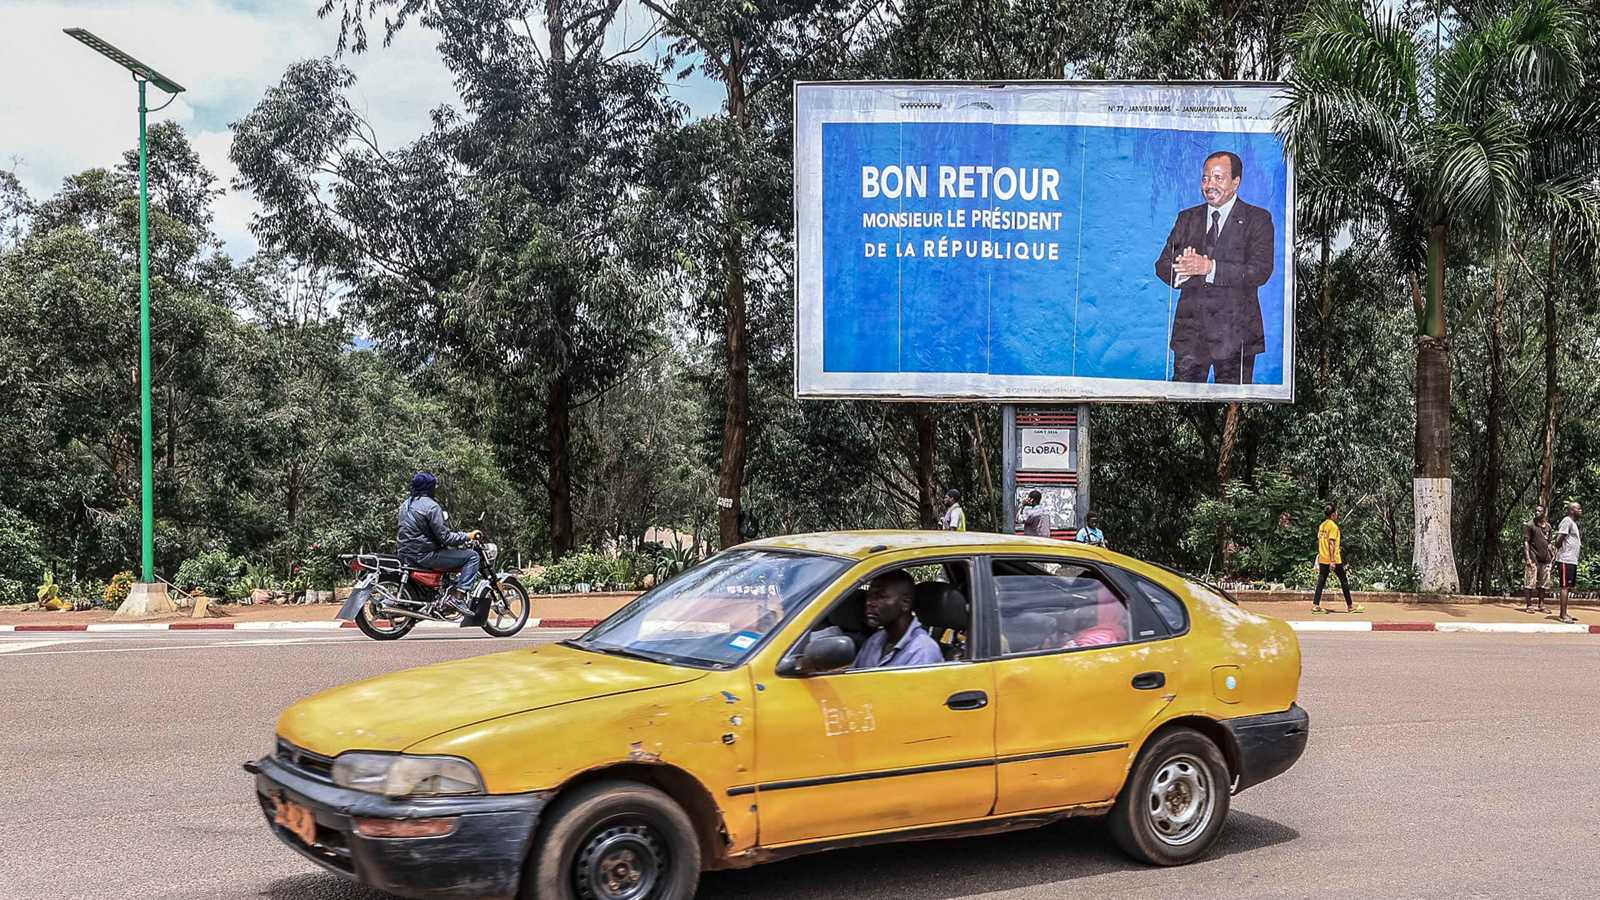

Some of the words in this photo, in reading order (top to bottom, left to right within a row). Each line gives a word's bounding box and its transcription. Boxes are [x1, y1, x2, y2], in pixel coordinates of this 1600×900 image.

[1116, 105, 1124, 113] 77
[1233, 105, 1247, 113] 2024
[862, 165, 927, 199] BON
[939, 165, 1060, 201] RETOUR
[863, 212, 943, 228] MONSIEUR
[947, 209, 966, 228] LE
[971, 207, 1062, 231] PRÉSIDENT
[864, 242, 887, 257] DE
[896, 243, 916, 257] LA
[924, 236, 1059, 261] RÉPUBLIQUE
[1024, 445, 1061, 454] GLOBAL
